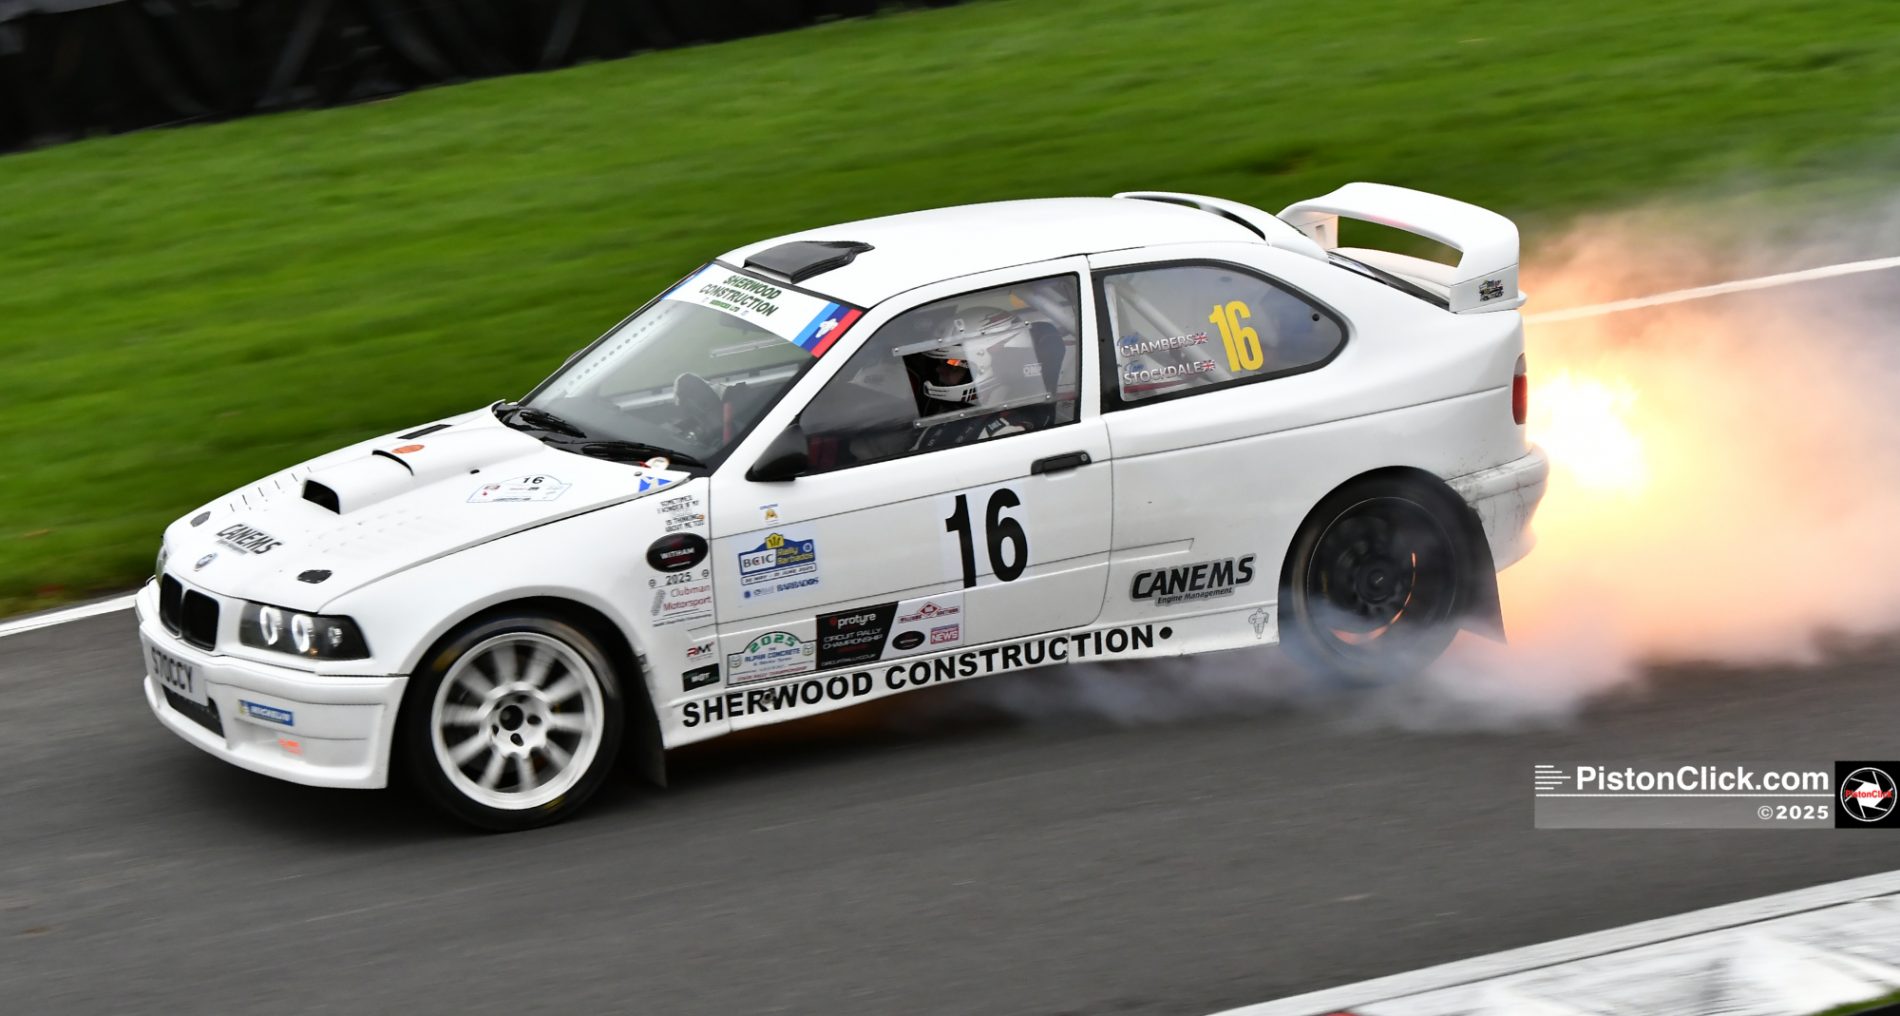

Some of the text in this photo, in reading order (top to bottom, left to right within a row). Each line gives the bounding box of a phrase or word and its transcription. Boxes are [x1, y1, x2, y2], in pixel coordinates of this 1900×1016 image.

[722, 275, 782, 299] SHERWOOD
[699, 284, 779, 316] CONSTRUCTION
[1120, 334, 1195, 358] CHAMBERS
[1209, 300, 1264, 372] 16
[1123, 361, 1203, 385] STOCKDALE
[523, 476, 545, 484] 16
[216, 524, 283, 555] CANEMS
[945, 487, 1028, 589] 16
[666, 571, 692, 586] 2025
[1132, 557, 1254, 599] CANEMS
[670, 584, 711, 598] Clubman
[1157, 587, 1233, 604] Engine Management
[663, 596, 712, 611] Motorsport
[837, 612, 876, 630] protyre
[750, 634, 796, 654] 2025
[823, 634, 883, 650] CHAMPIONSHIP
[824, 627, 882, 643] CIRCUIT RALLY
[931, 630, 958, 643] NEWS
[682, 624, 1154, 728] SHERWOOD CONSTRUCTION
